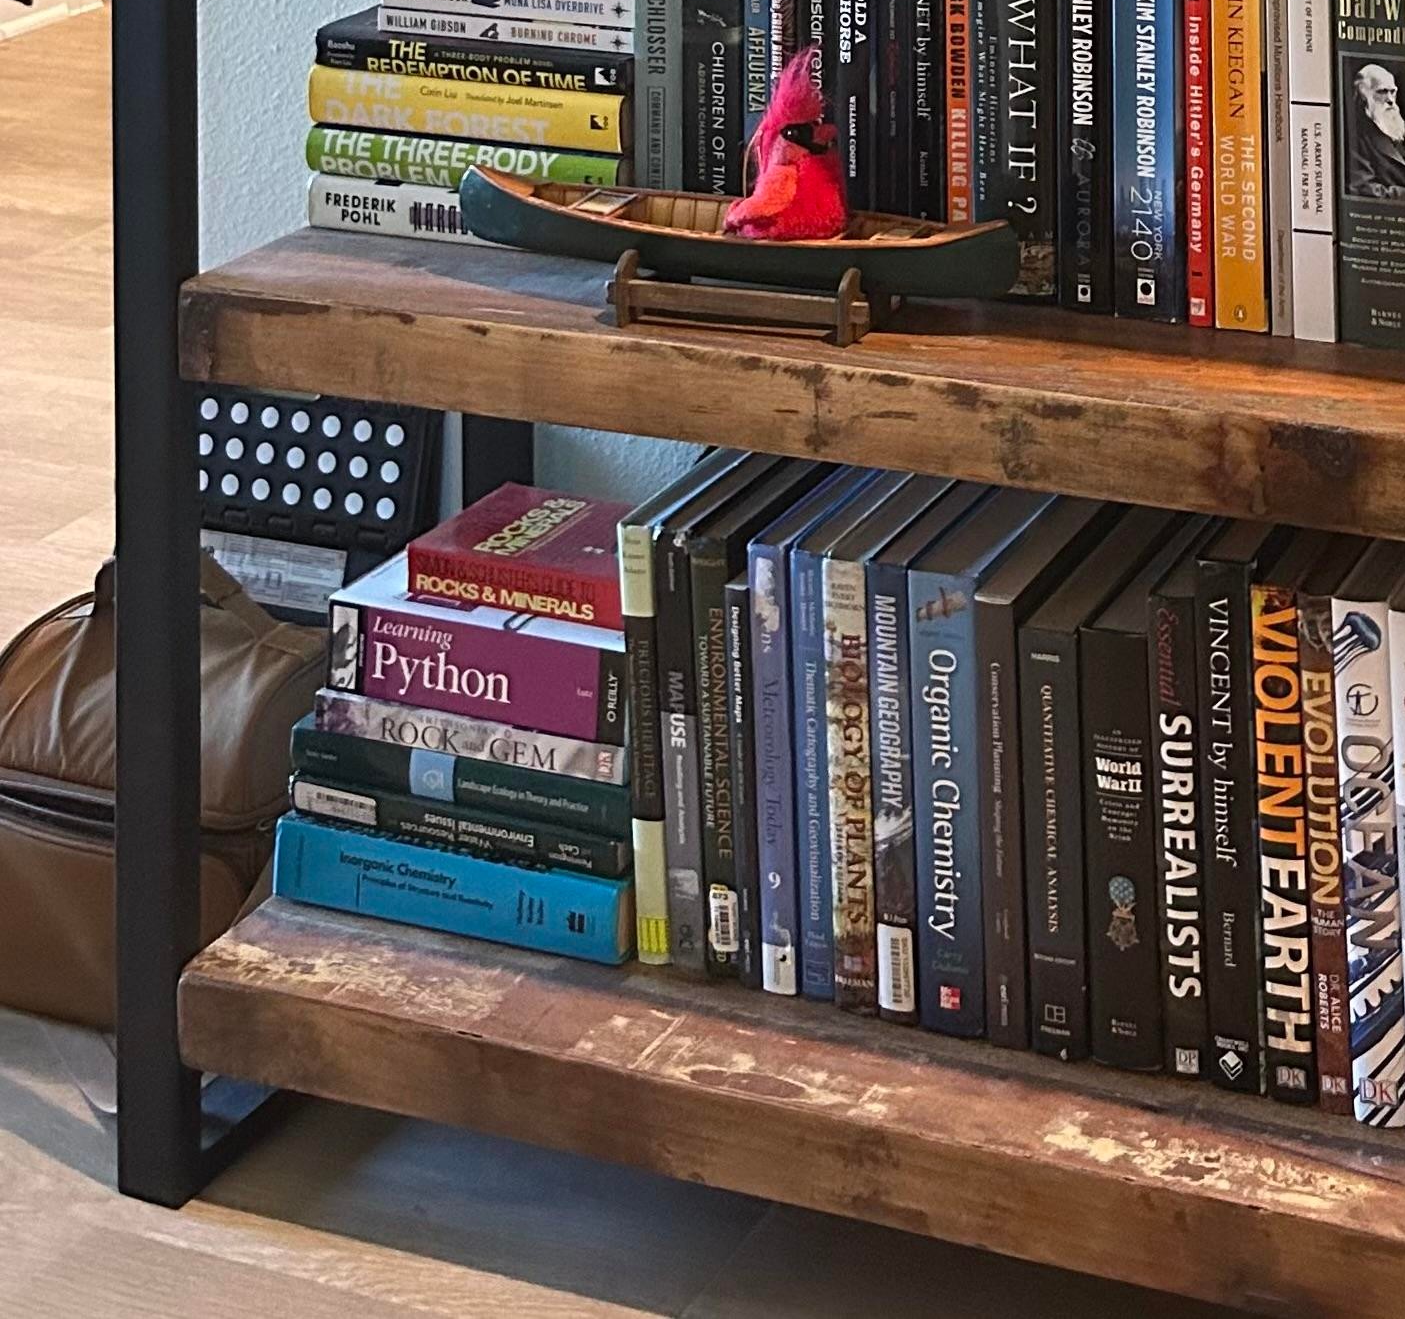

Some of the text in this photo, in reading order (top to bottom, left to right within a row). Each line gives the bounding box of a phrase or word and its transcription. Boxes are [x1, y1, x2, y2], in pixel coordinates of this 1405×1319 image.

[1072, 39, 1093, 126] ROBINSON
[1228, 25, 1246, 118] KEEGAN
[1009, 139, 1036, 182] IF
[1188, 16, 1204, 252] Inside Hitler's Germany
[326, 193, 395, 212] FREDERIK
[341, 210, 380, 225] POHL
[1008, 199, 1037, 214] ?
[416, 574, 594, 621] ROCKS & MINERALS
[373, 617, 453, 649] Learning
[373, 642, 510, 704] Python
[922, 649, 961, 940] Organic Chemistry
[1159, 714, 1201, 998] SURREALISTS
[1252, 607, 1313, 1054] VIOLENT EARTH
